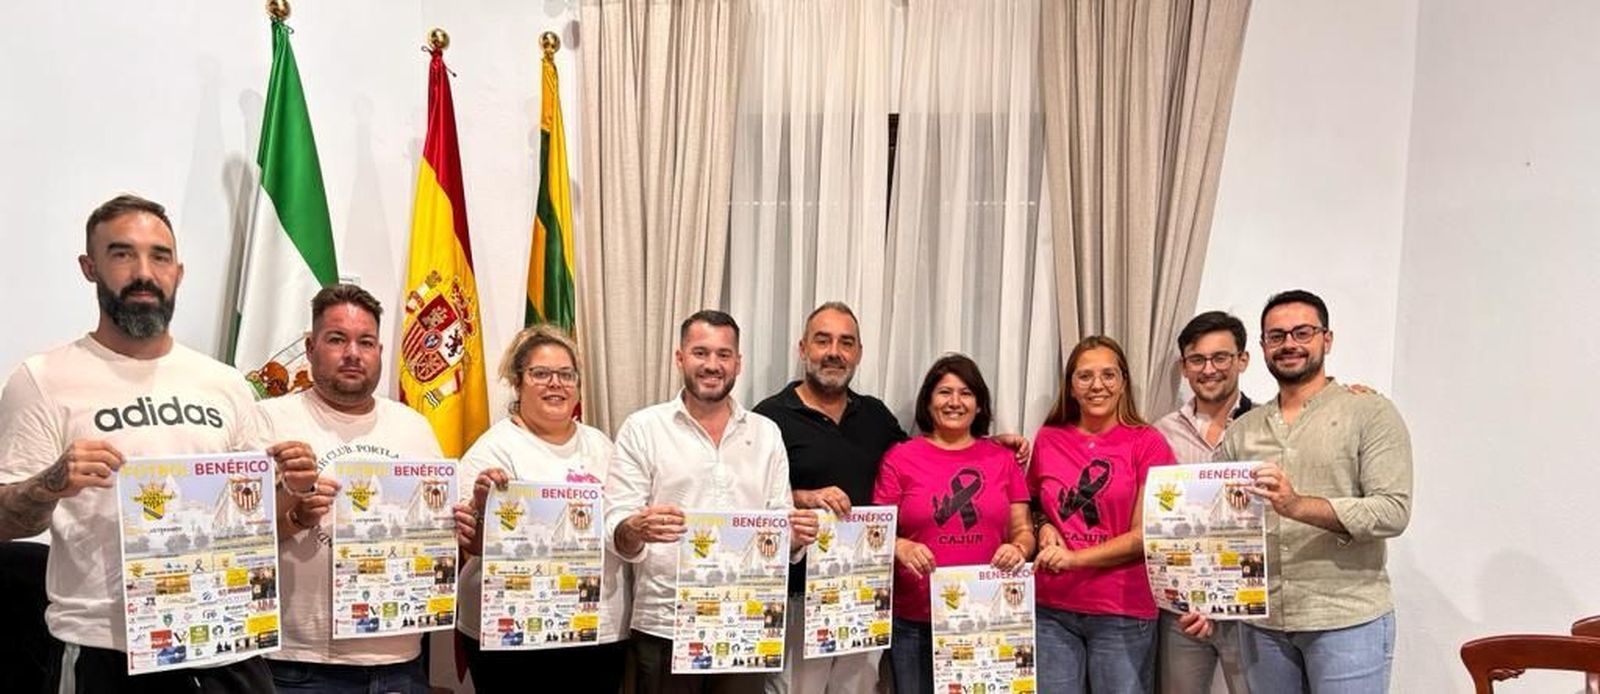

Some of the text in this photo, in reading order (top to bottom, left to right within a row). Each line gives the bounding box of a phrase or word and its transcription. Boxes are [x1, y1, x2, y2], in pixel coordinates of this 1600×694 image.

[94, 396, 223, 432] adidas
[194, 458, 269, 476] BENÉFICO
[394, 463, 455, 476] BENÉFICO
[541, 487, 598, 500] BENÉFICO
[732, 515, 787, 528] BENÉFICO
[938, 534, 983, 545] CAJUN
